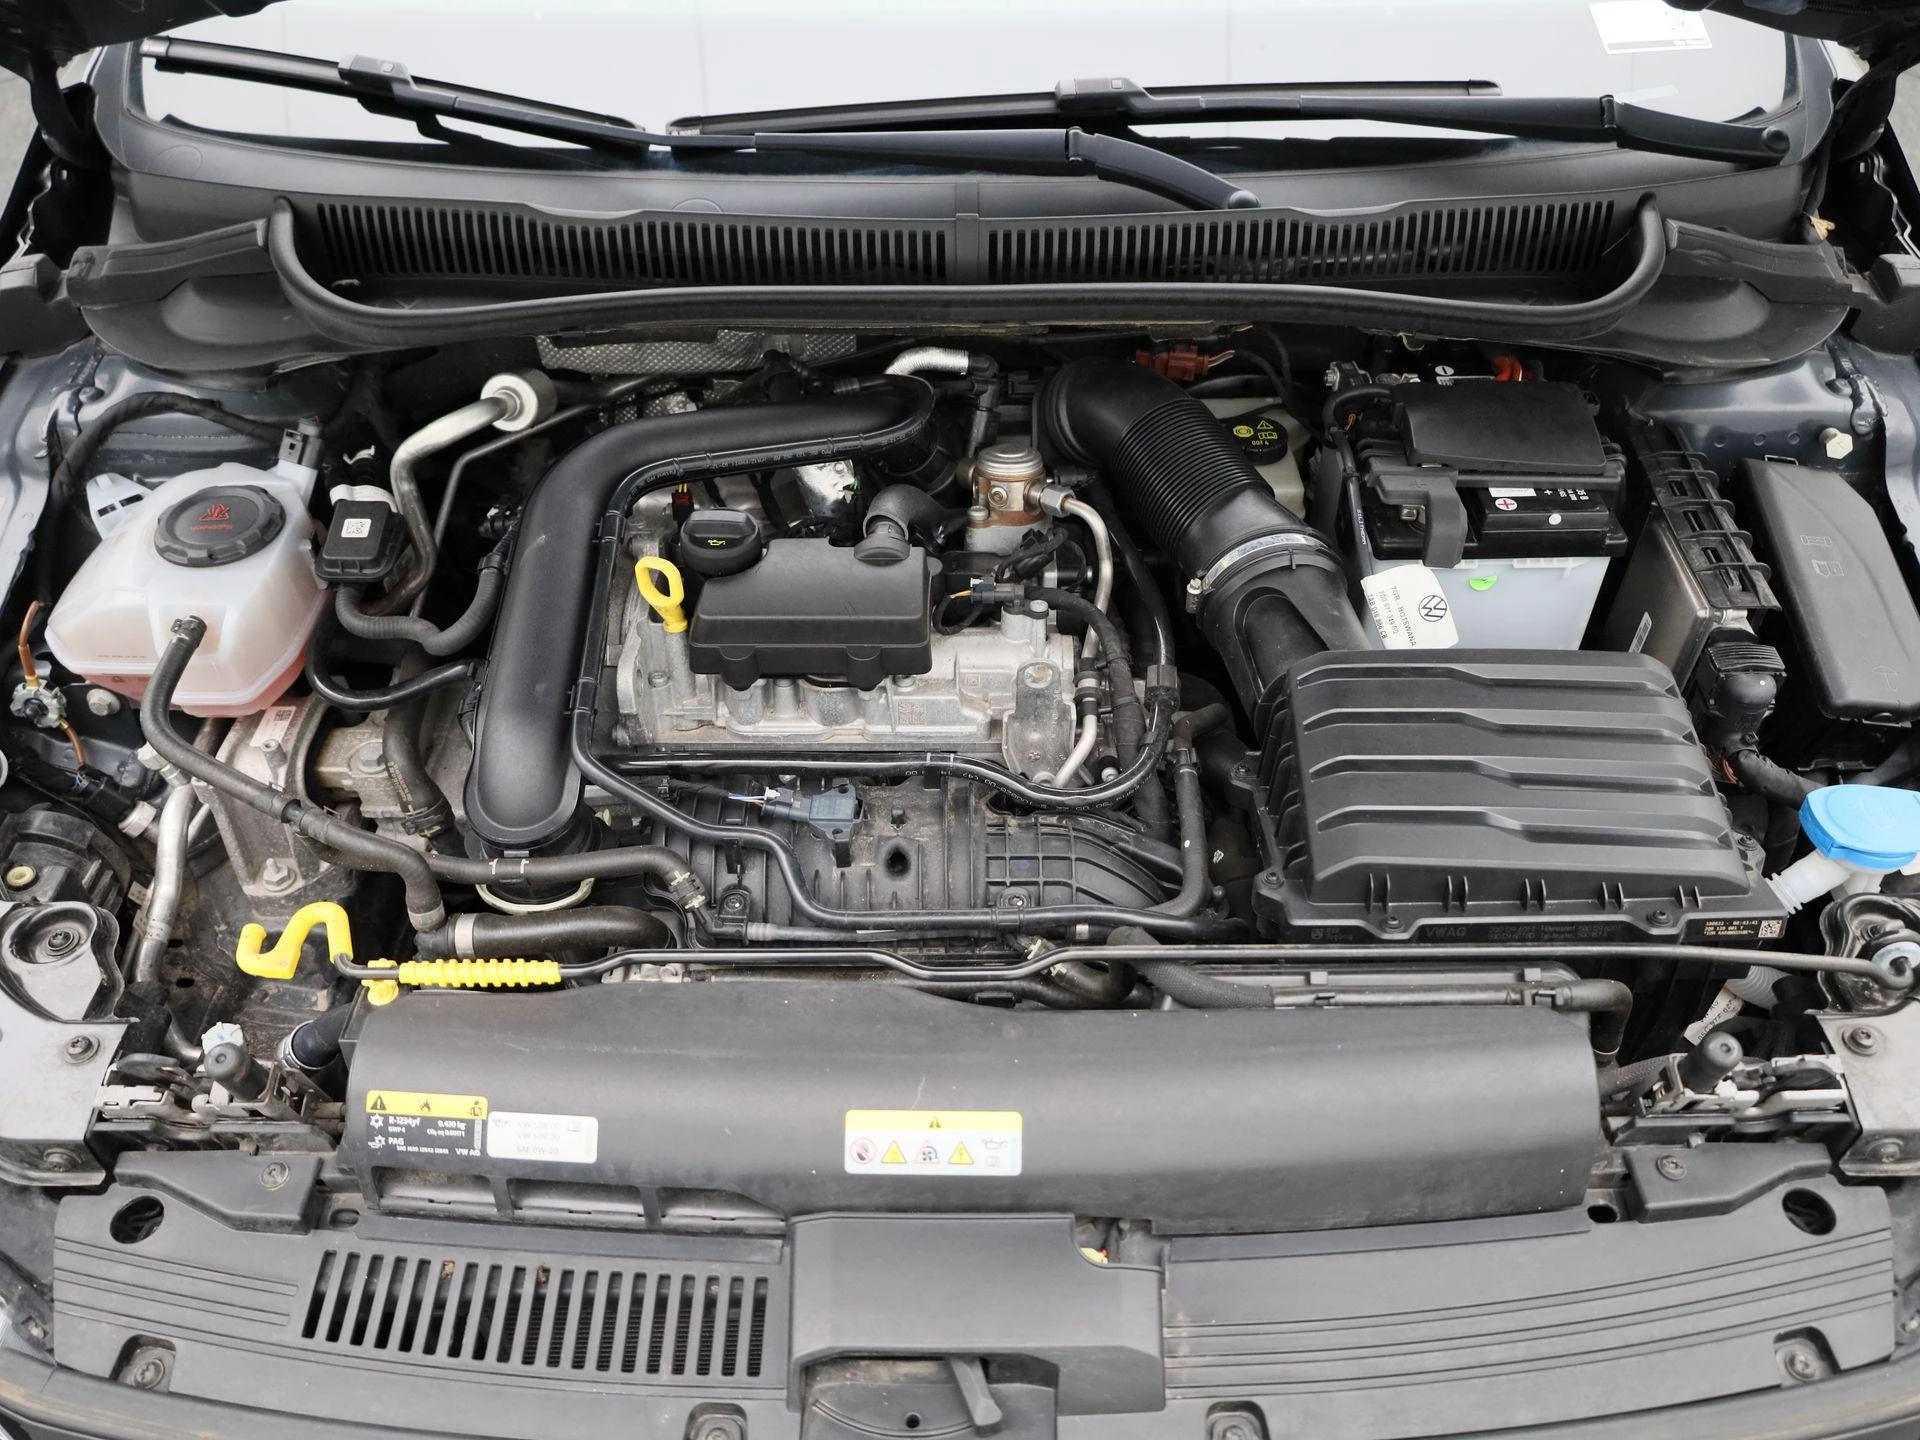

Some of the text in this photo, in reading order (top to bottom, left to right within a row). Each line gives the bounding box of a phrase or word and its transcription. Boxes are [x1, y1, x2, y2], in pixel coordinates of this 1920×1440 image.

[1397, 606, 1416, 647] BOTSWANA
[388, 1115, 420, 1127] R-1234yf
[388, 1137, 404, 1145] PAG
[455, 1148, 481, 1157] VW AG
